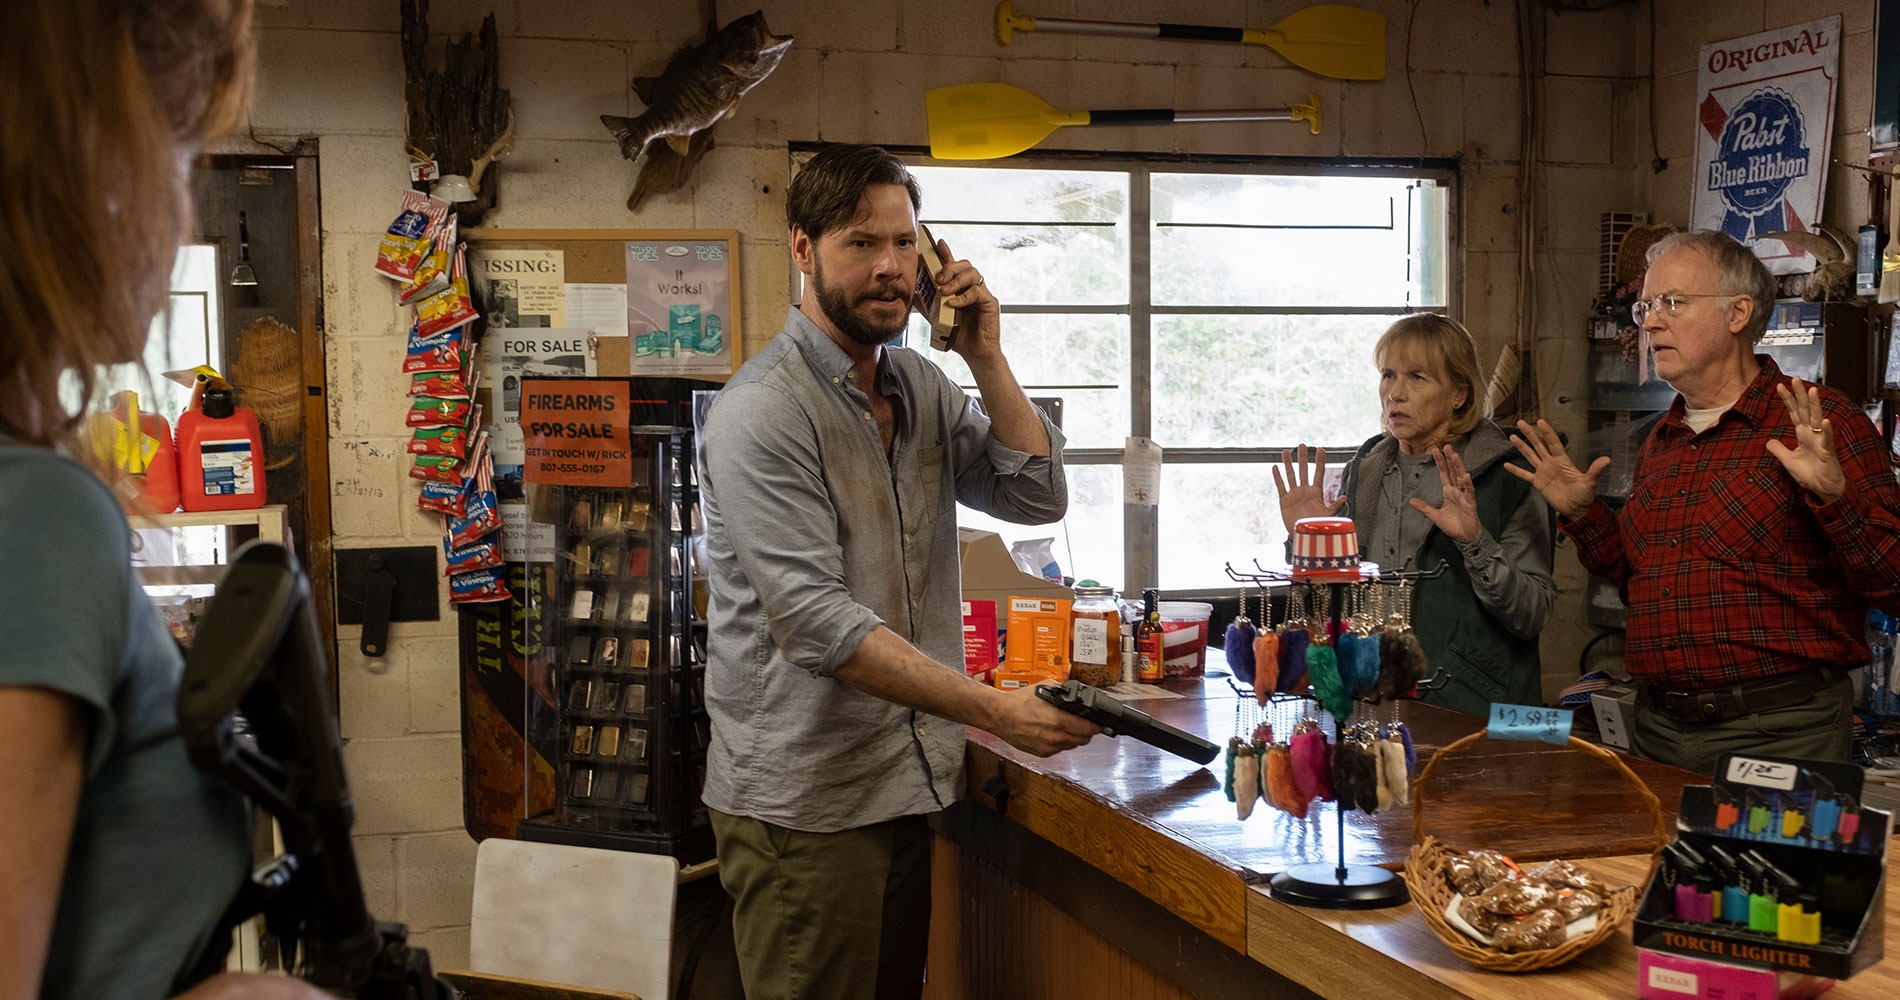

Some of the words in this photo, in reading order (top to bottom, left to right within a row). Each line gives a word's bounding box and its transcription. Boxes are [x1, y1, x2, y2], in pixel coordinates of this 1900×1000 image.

[1708, 29, 1830, 74] ORIGINAL
[1732, 112, 1790, 152] Pabst
[1709, 161, 1748, 190] Blue
[1748, 154, 1808, 185] Ribbon
[1744, 187, 1768, 197] BEER
[631, 251, 660, 262] TOES
[695, 251, 724, 261] TOES
[484, 259, 557, 273] ISSING:
[675, 269, 684, 280] It
[657, 283, 703, 295] Works!
[504, 340, 537, 353] FOR
[541, 339, 583, 353] SALE
[528, 394, 616, 412] FIREARMS
[531, 422, 566, 439] FOR
[567, 423, 615, 440] SALE
[526, 447, 541, 456] GET
[542, 448, 550, 457] IN
[551, 448, 585, 458] TOUCH
[587, 450, 600, 461] W/
[602, 450, 627, 459] RICK
[540, 462, 606, 474] 807-555-0167
[428, 485, 459, 496] Vinegar
[460, 576, 495, 587] Vinegar
[1041, 602, 1055, 610] Kids
[1499, 708, 1542, 727] $2.59
[1663, 932, 1724, 954] TORCH
[1731, 943, 1813, 968] LIGHTER
